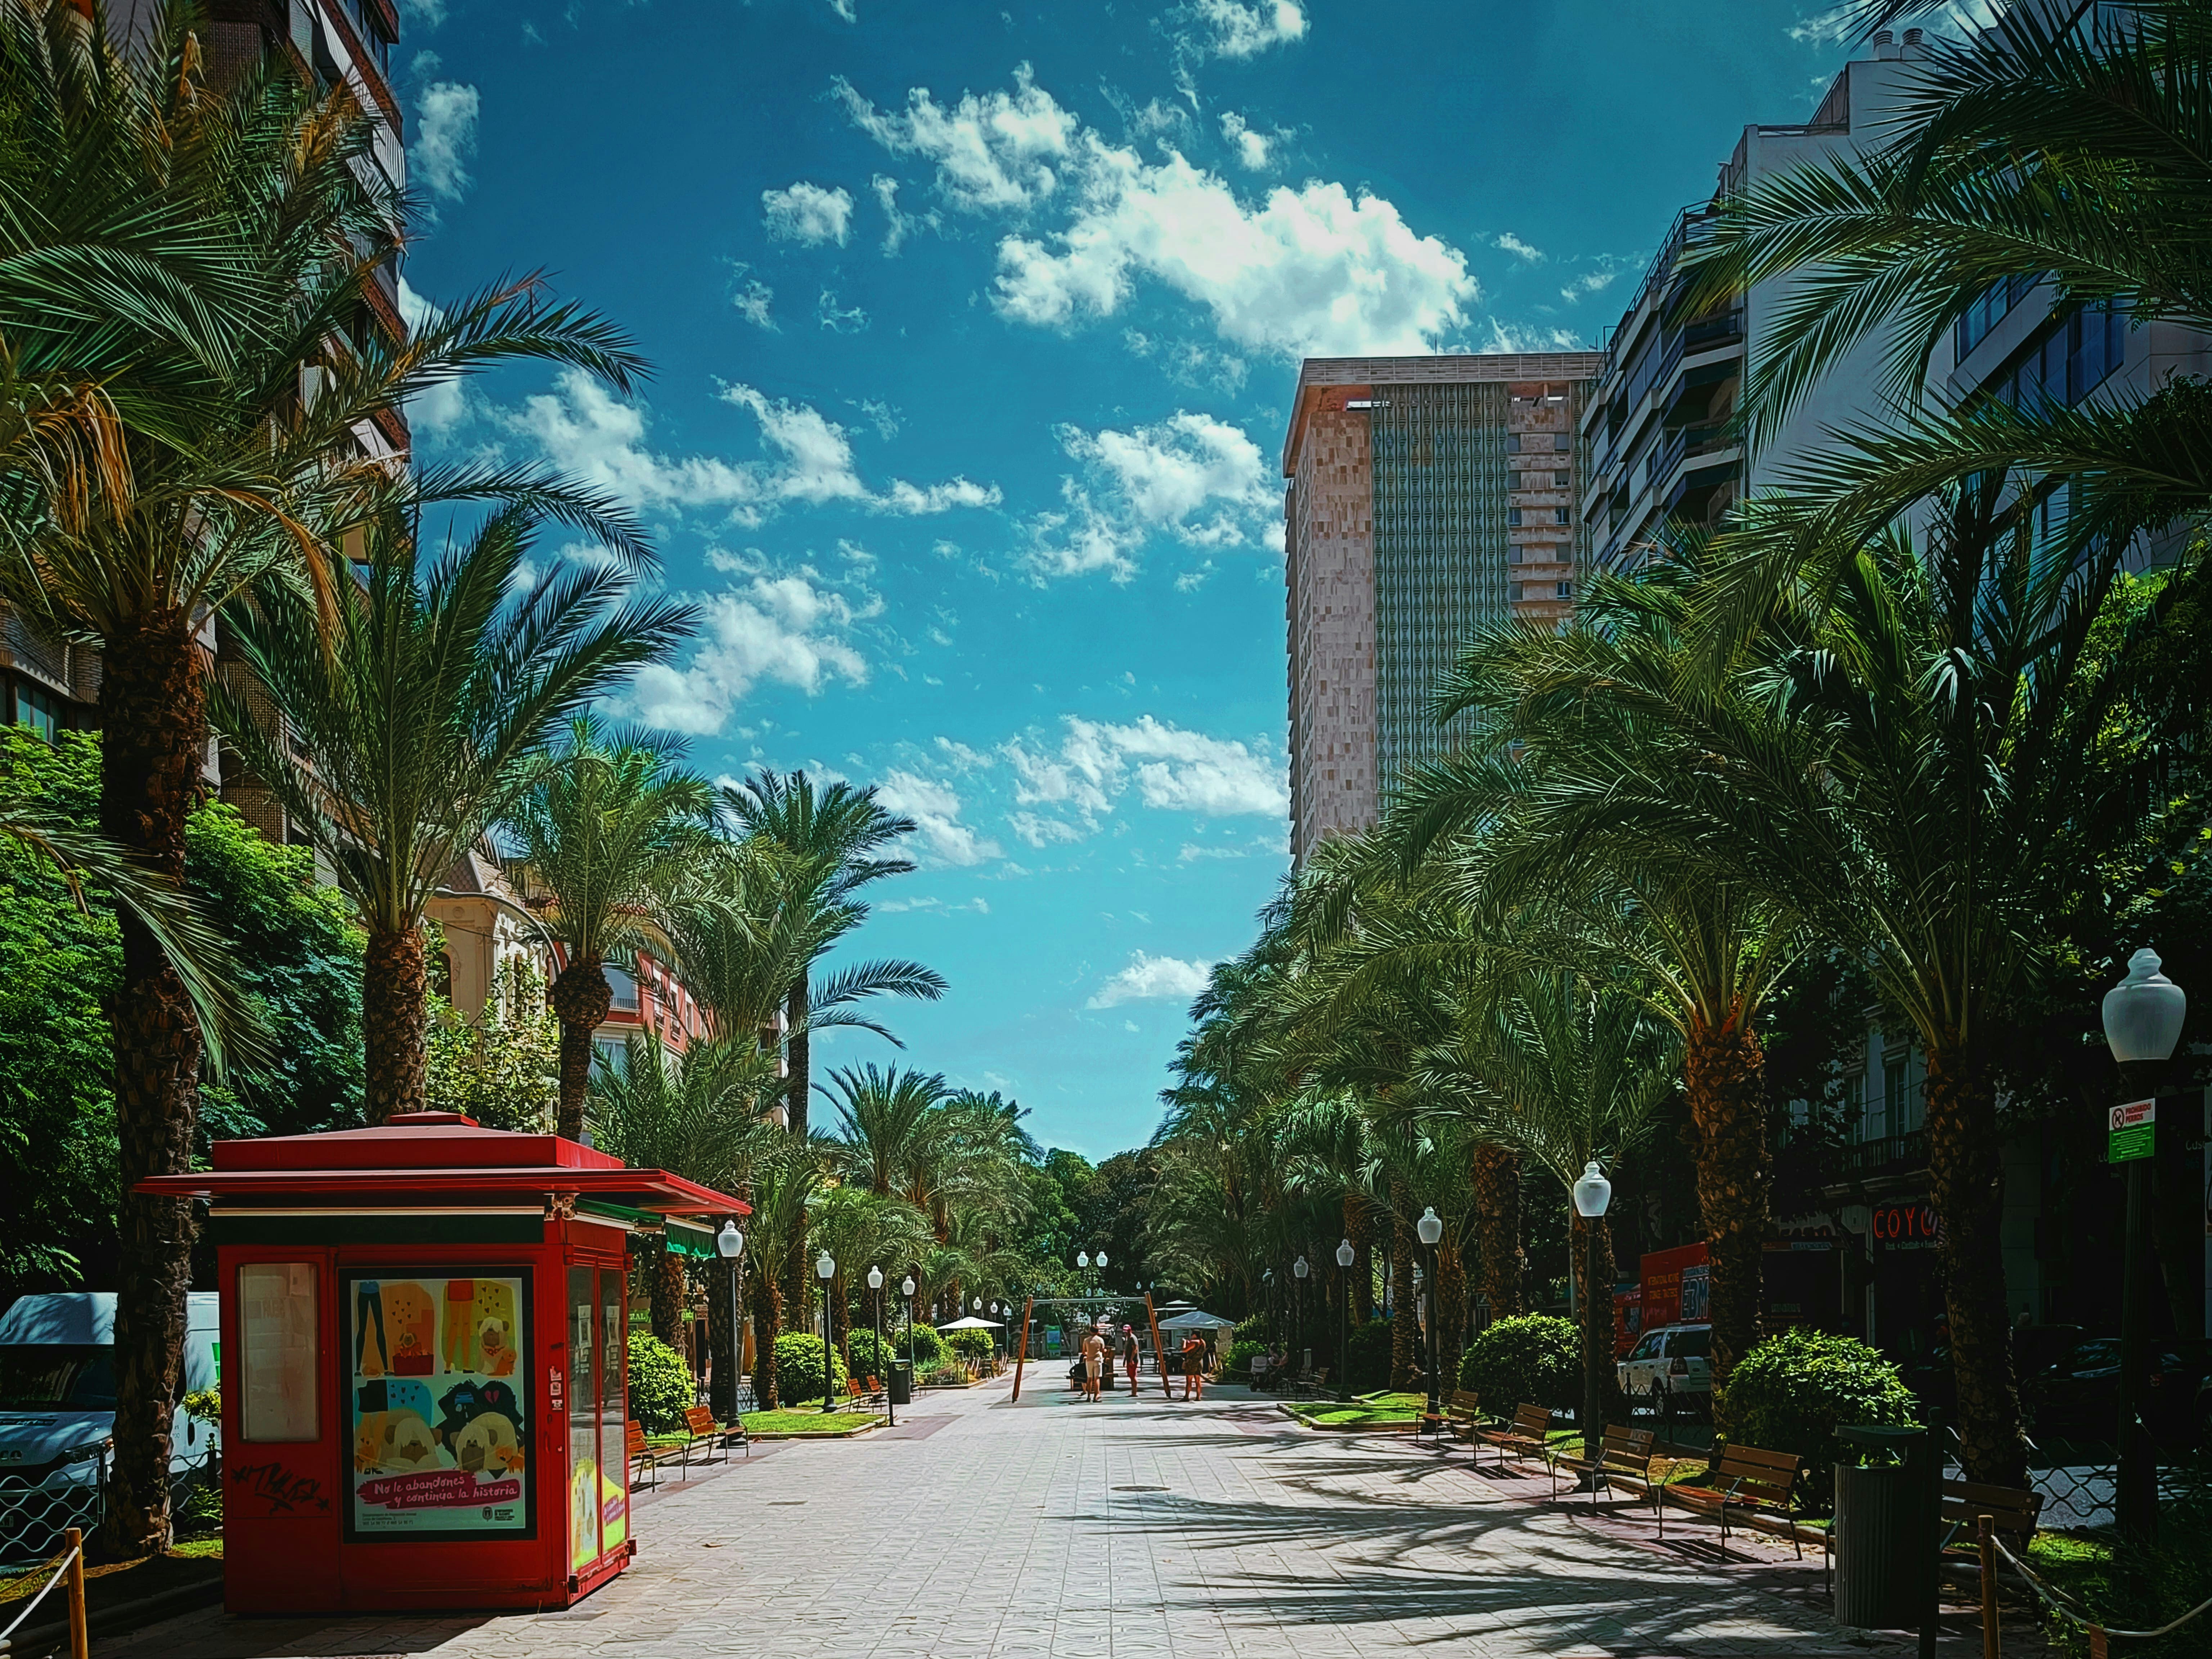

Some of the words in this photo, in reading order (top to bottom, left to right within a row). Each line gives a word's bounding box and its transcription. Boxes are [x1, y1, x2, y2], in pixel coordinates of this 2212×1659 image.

[2125, 1103, 2152, 1115] PROHIBIDO
[2125, 1113, 2144, 1123] PERROS
[374, 1483, 390, 1495] No
[394, 1481, 403, 1492] le
[406, 1475, 465, 1491] abandones
[394, 1496, 401, 1508] y
[406, 1489, 455, 1502] continúa
[458, 1488, 469, 1498] la
[473, 1486, 518, 1498] historia
